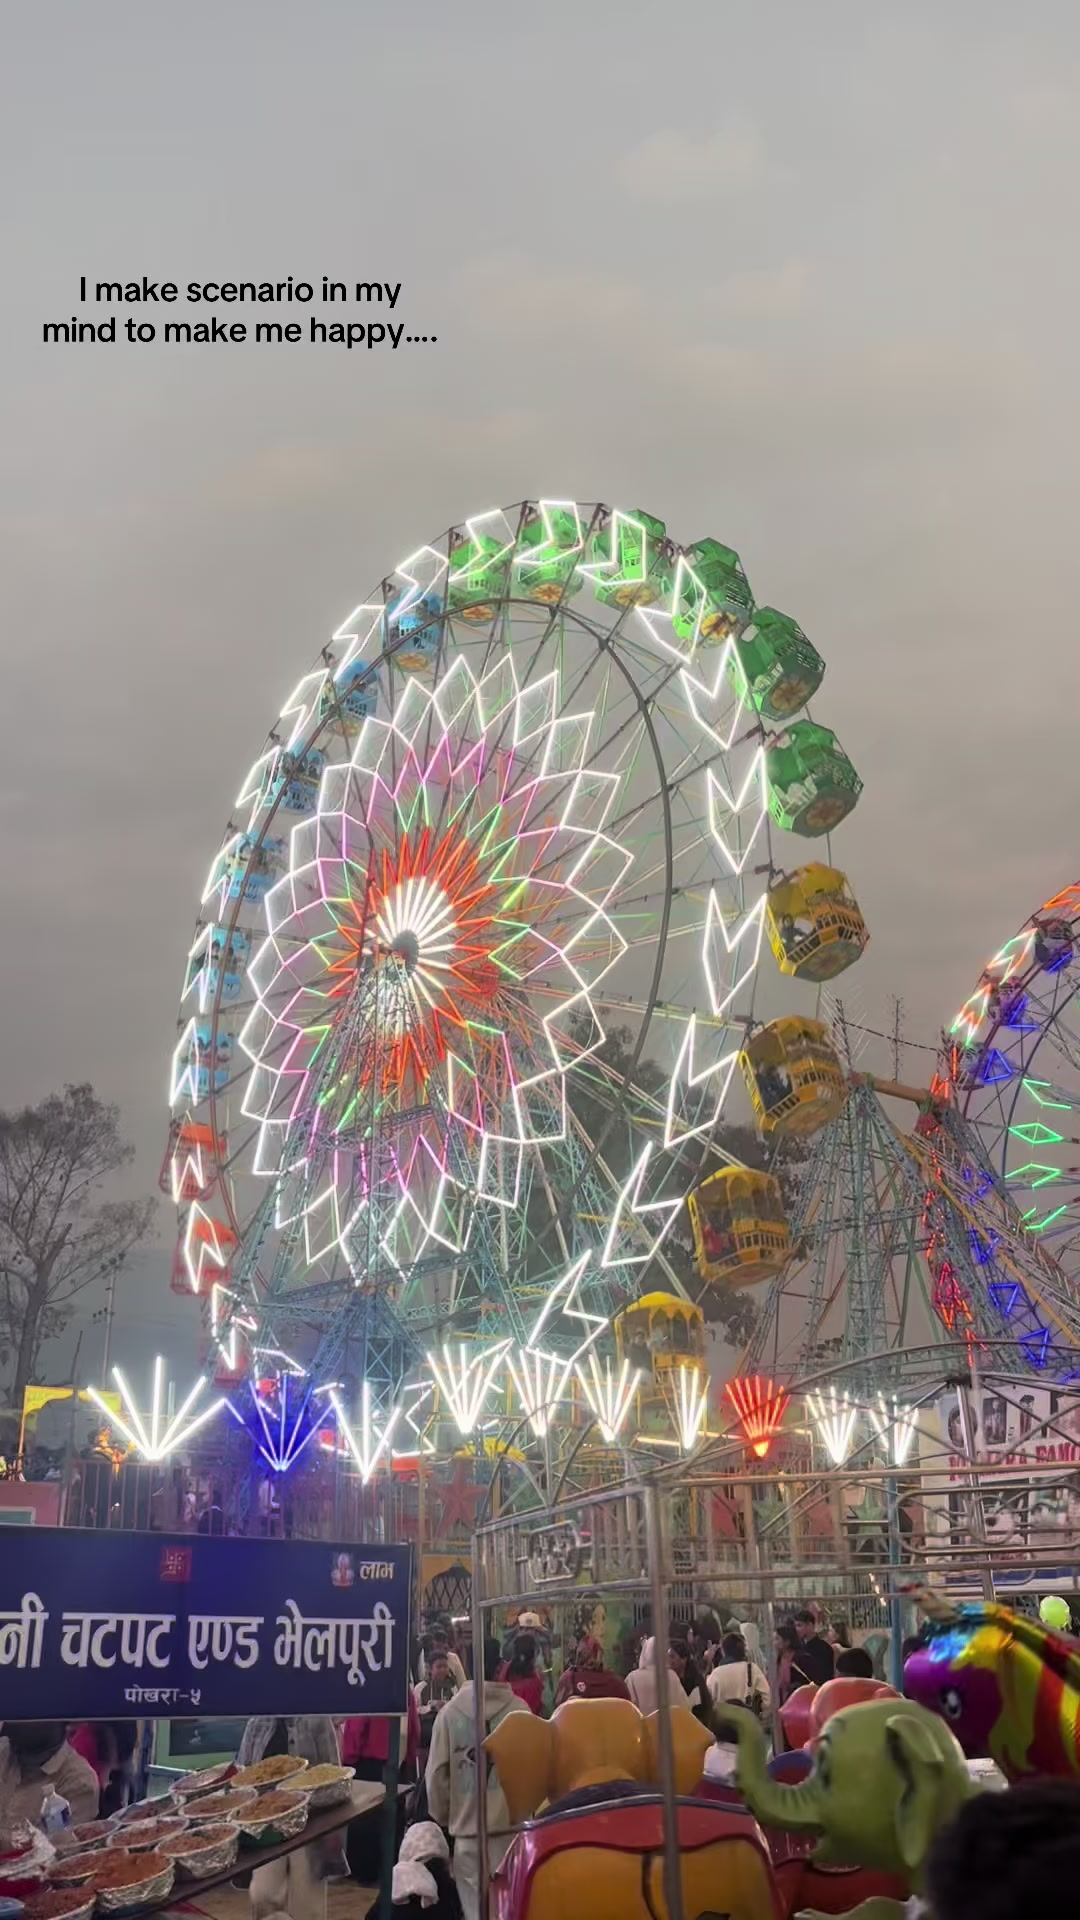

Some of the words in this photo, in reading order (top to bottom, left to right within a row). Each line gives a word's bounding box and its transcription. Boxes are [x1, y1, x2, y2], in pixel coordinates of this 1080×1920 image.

[359, 1560, 395, 1580] लाभ
[61, 1612, 176, 1668] चटपट
[188, 1615, 264, 1670] एण्ड
[274, 1599, 396, 1686] भेलपूरी
[124, 1684, 201, 1706] पोखरा-५
